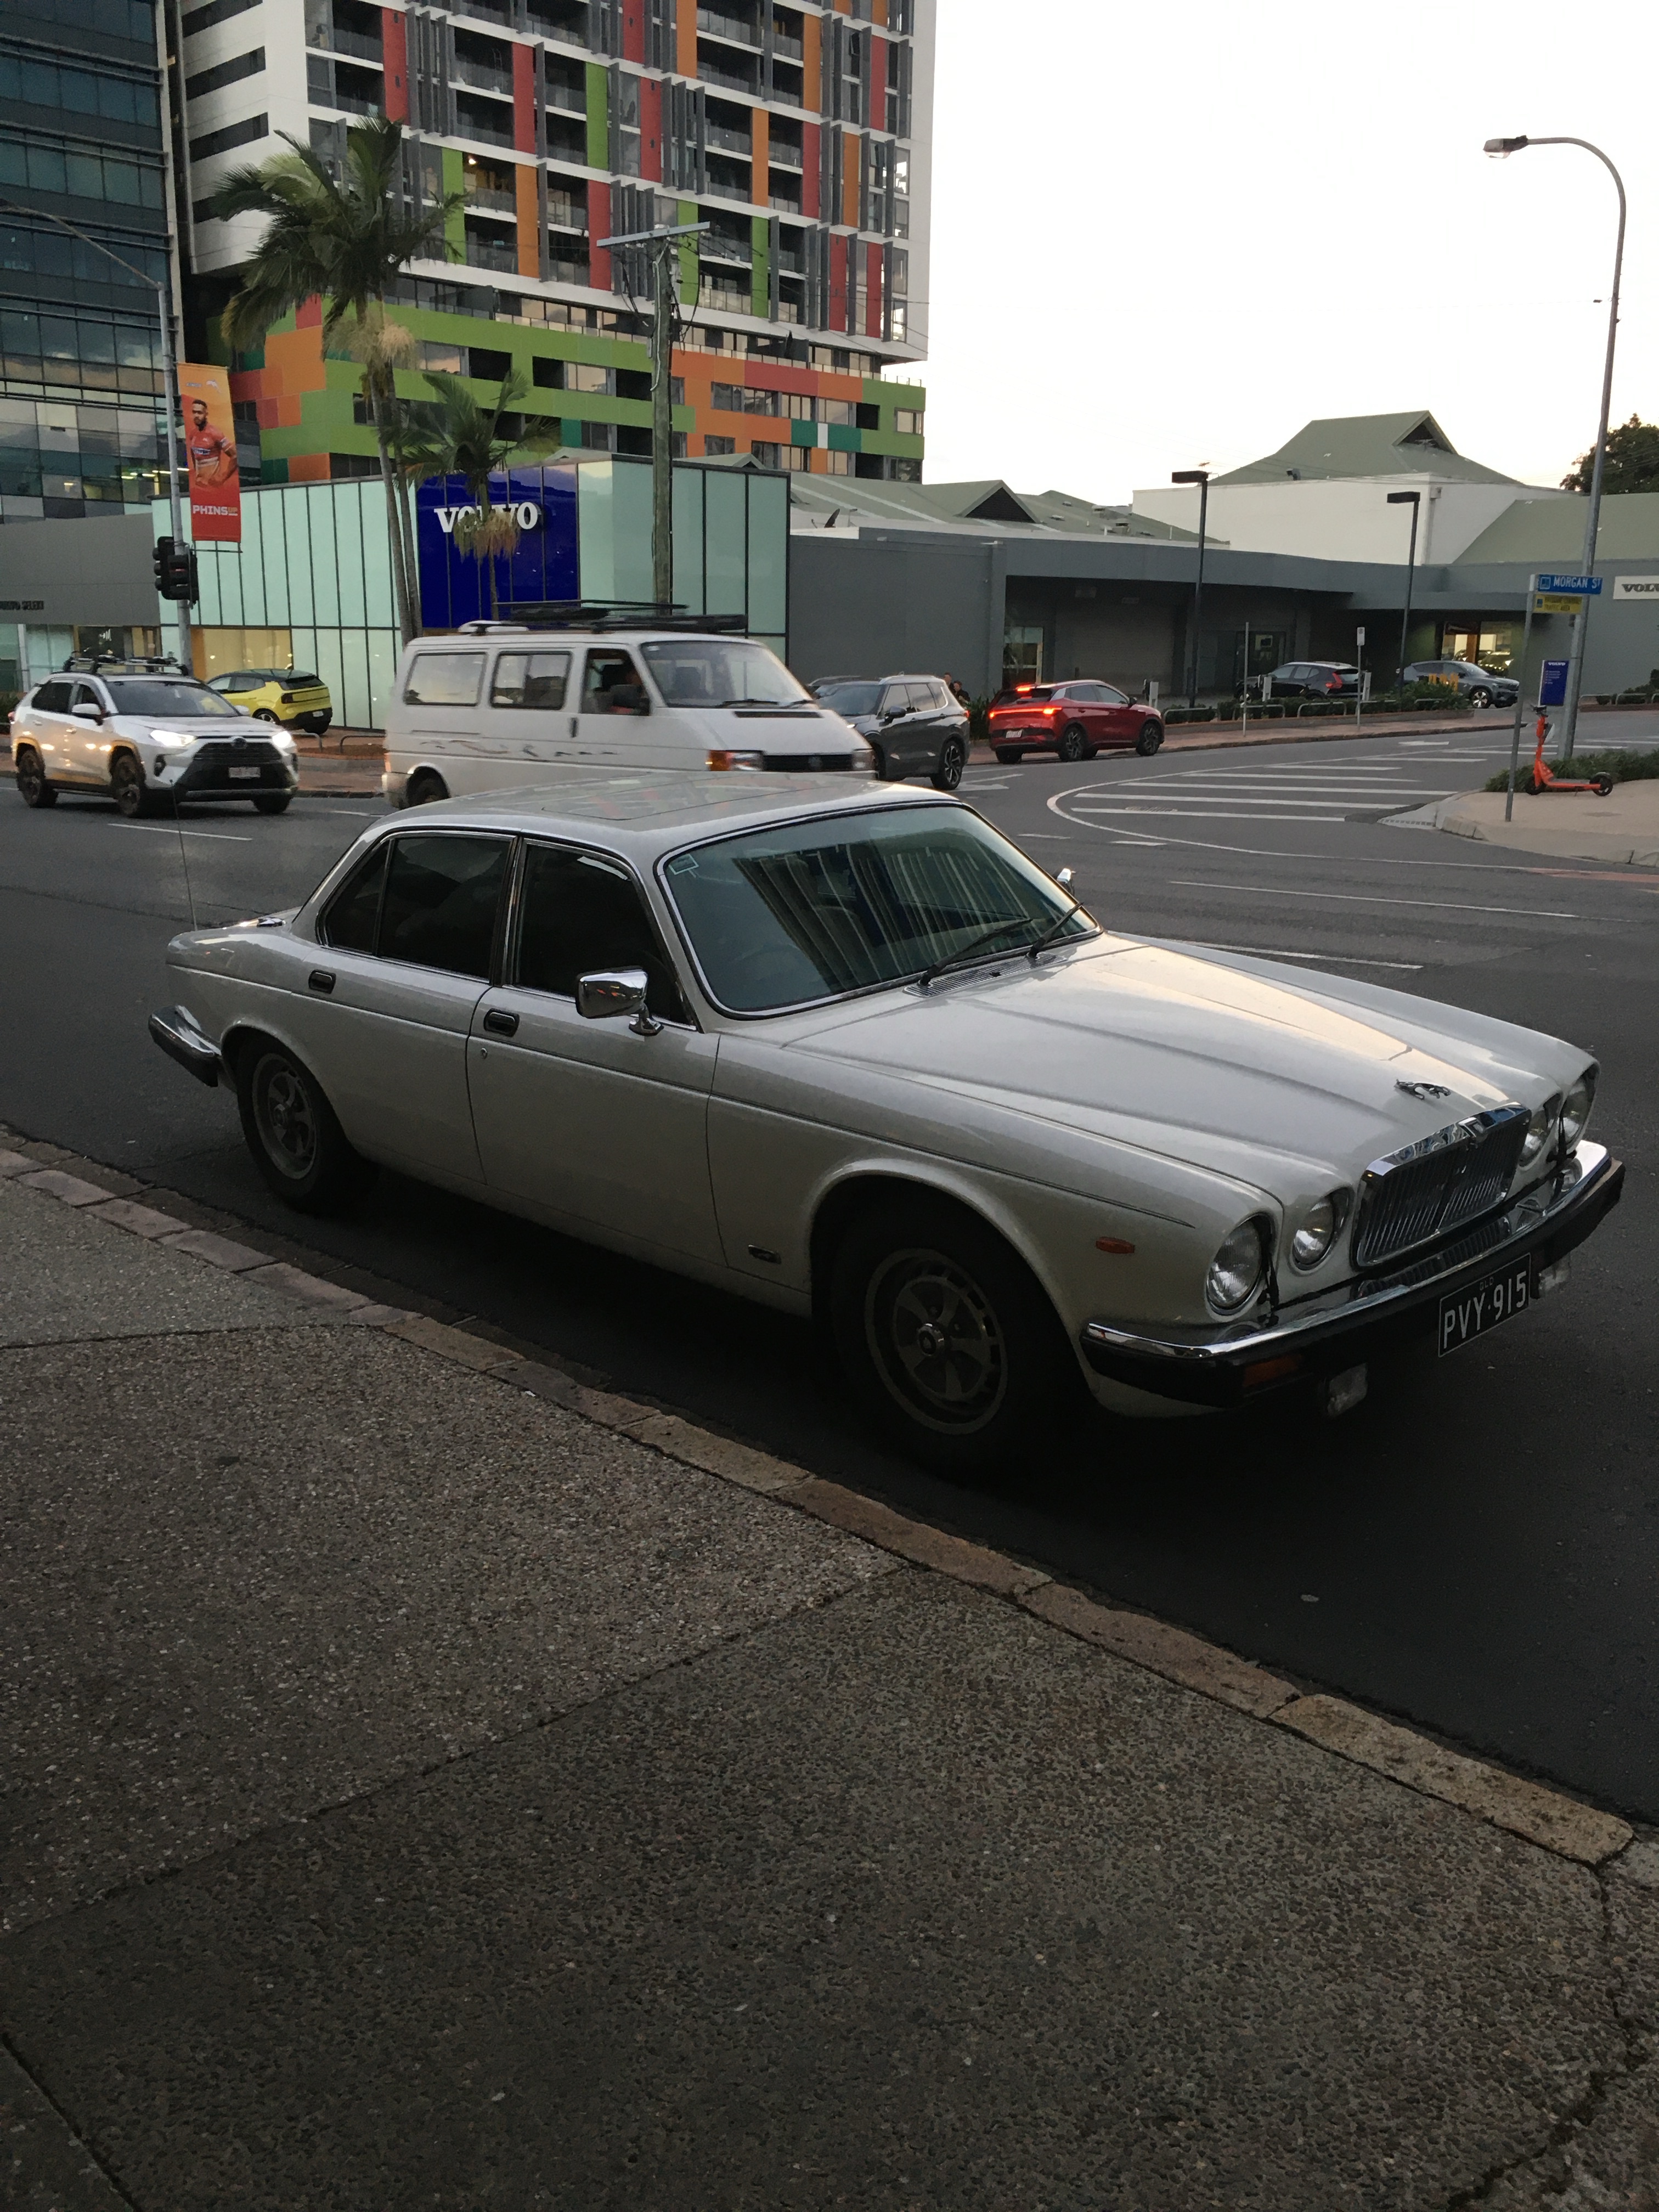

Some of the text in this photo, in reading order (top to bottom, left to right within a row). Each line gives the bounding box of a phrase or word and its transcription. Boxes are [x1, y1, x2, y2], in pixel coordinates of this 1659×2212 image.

[1553, 576, 1601, 589] MORGAN ST
[1480, 1277, 1494, 1291] QLD
